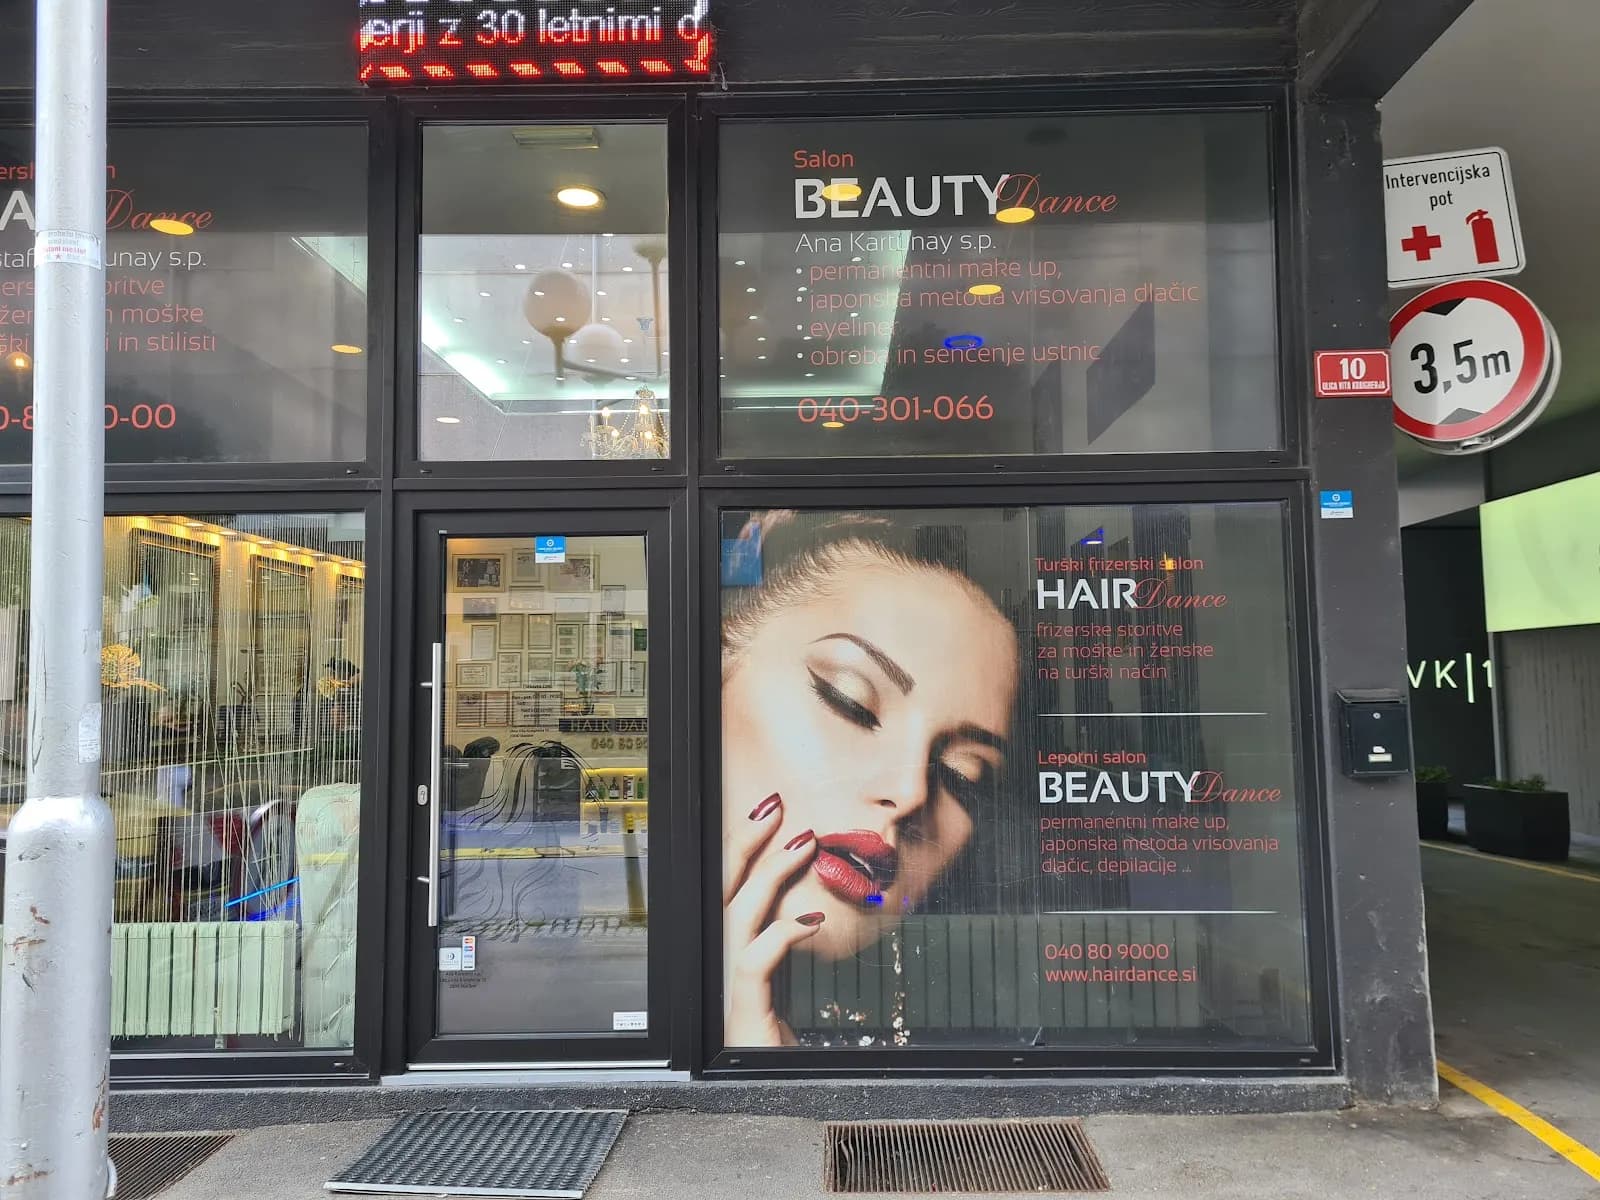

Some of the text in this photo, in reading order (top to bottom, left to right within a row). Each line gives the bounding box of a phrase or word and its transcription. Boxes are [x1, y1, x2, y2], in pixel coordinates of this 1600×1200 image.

[439, 19, 462, 45] z
[476, 9, 525, 44] 30
[539, 7, 662, 43] letnimi
[793, 150, 855, 168] Salon
[1384, 163, 1491, 190] Intervencijska
[794, 173, 1120, 219] BEAUTY Dance
[1429, 191, 1454, 211] pot
[795, 232, 842, 253] Ana
[960, 233, 997, 253] s.p.
[169, 250, 207, 270] s.p.
[809, 258, 1063, 284] permanentni make up,
[920, 285, 1005, 307] metoda
[1011, 283, 1126, 306] vrisovanja
[1134, 281, 1201, 304] dlačic
[122, 303, 204, 324] moške
[809, 319, 899, 341] eyeliner
[118, 331, 139, 352] in
[147, 331, 216, 352] stilisti
[810, 346, 889, 366] obroba
[897, 344, 917, 365] in
[1032, 340, 1101, 362] ustnic
[1339, 357, 1367, 380] 10
[797, 394, 995, 424] 040-301-066
[1035, 556, 1205, 573] Turški frizerski salon
[1036, 575, 1228, 610] HAIR Dance
[1037, 622, 1184, 638] frizerske storitve
[1038, 642, 1214, 659] za moške in ženske
[1038, 663, 1167, 680] na turški način
[1038, 750, 1147, 767] Lepotni salon
[1038, 770, 1282, 804] BEAUTY Dance
[1040, 813, 1231, 832] permanentni make up,
[1040, 835, 1280, 854] japonska metoda vrisovanja
[1042, 857, 1093, 875] dlačic,
[1097, 857, 1177, 875] depilacije
[1045, 943, 1170, 960] 040 80 9000
[1045, 966, 1197, 983] www.hairdance.si
